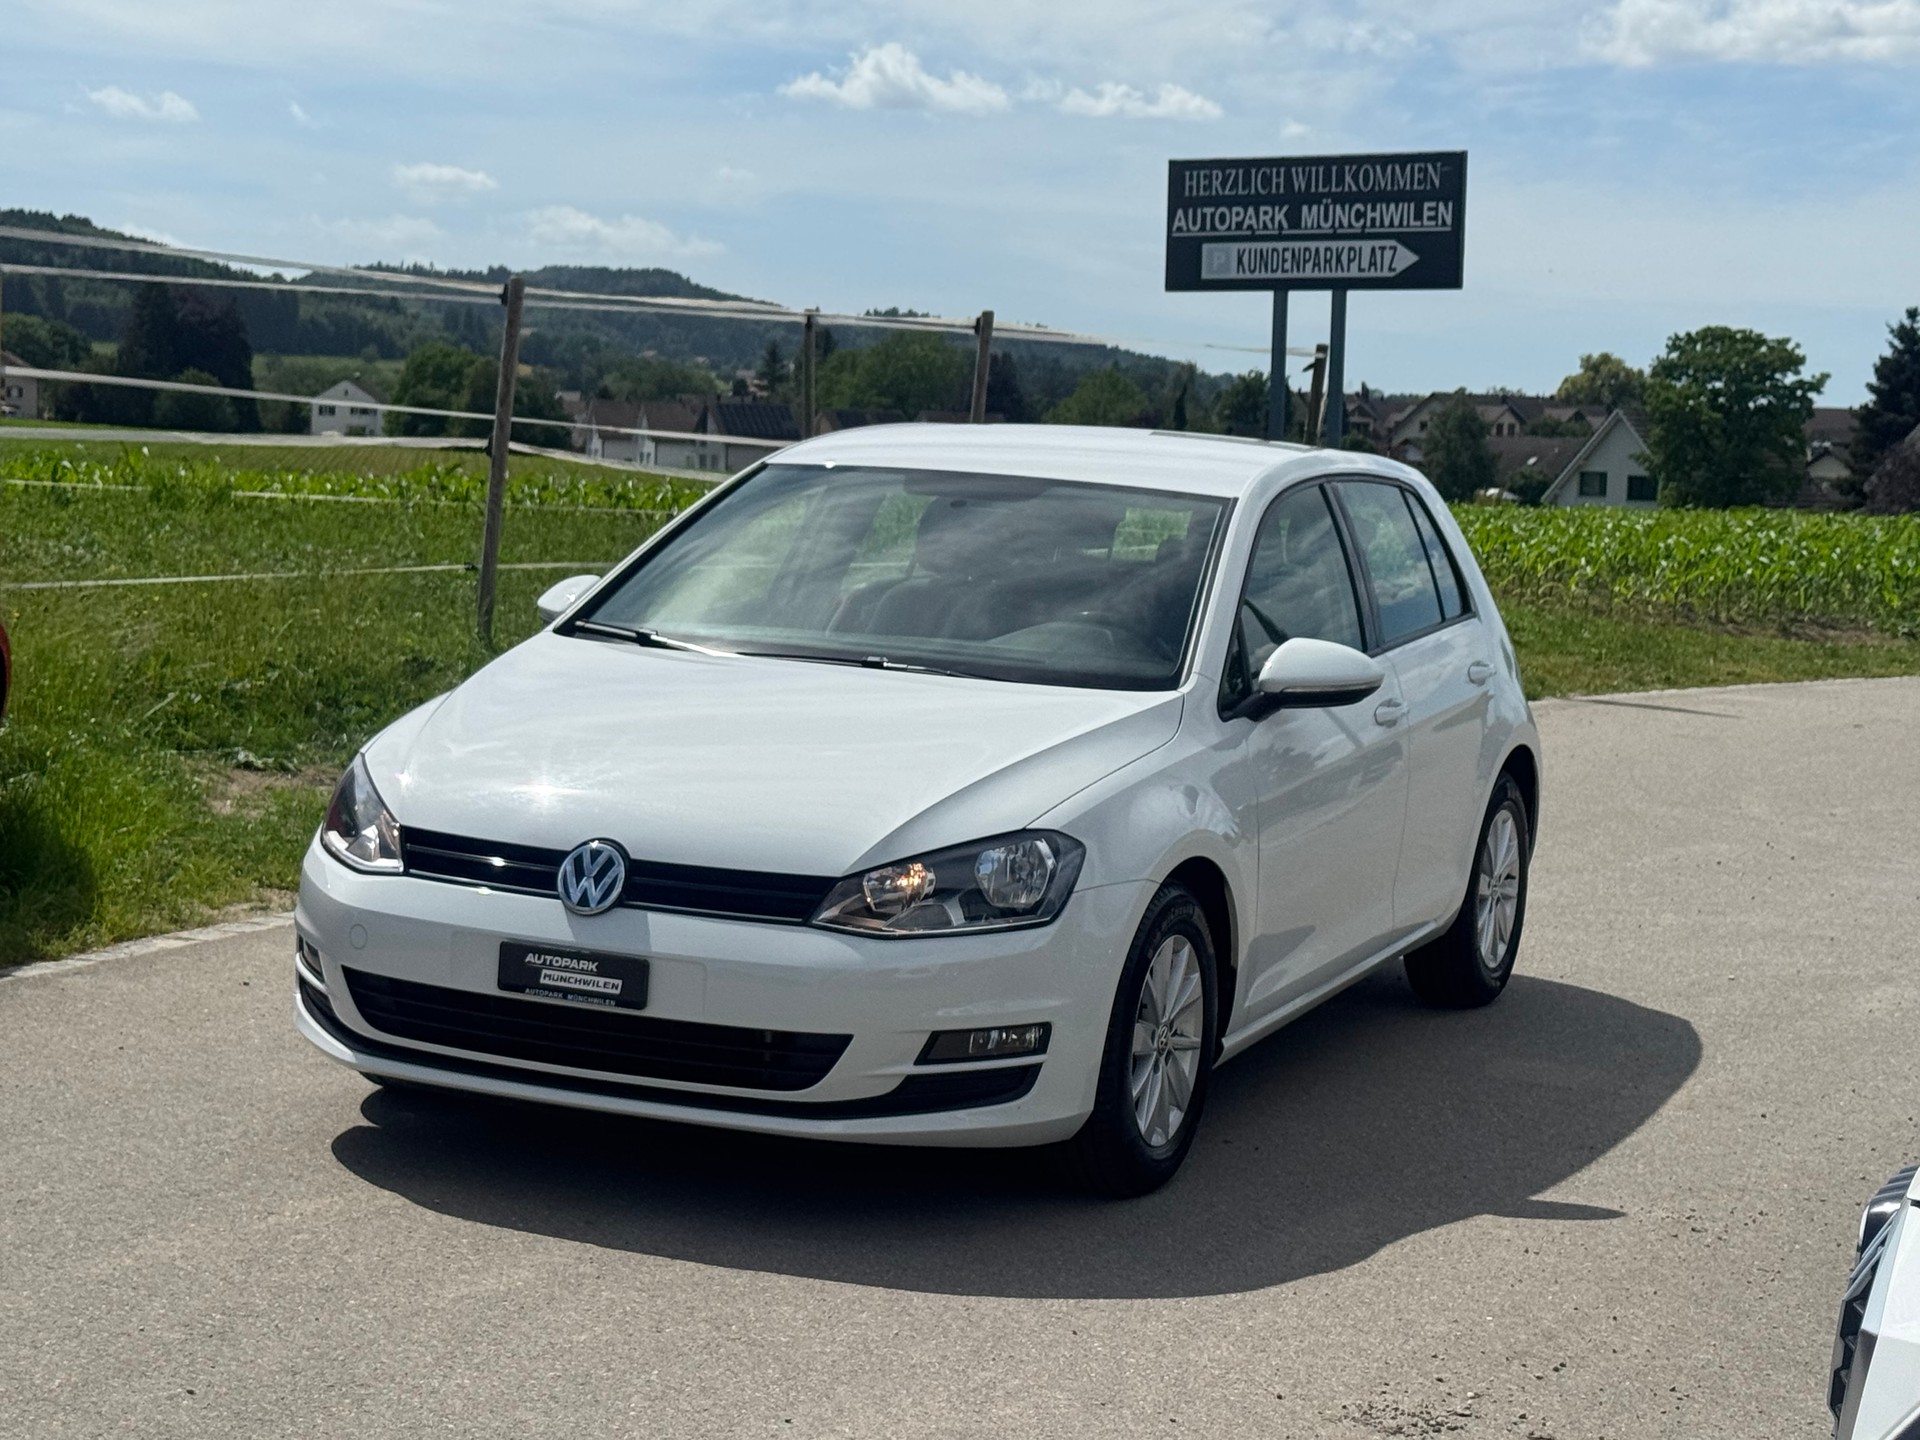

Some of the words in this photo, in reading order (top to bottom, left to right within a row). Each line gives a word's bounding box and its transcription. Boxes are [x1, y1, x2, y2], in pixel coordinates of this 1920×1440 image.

[1185, 167, 1286, 197] HERZLICH
[1291, 162, 1442, 193] WILLKOMMEN
[1172, 205, 1289, 232] AUTOPARK
[1301, 199, 1453, 228] MÜNCHWILEN
[1237, 246, 1398, 274] KUNDENPARKPLATZ
[559, 843, 625, 915] VW
[525, 953, 599, 971] AUTOPARK
[543, 971, 620, 991] MÜNCHWILEN
[525, 987, 563, 998] AUTOPARK
[567, 993, 616, 1006] MÜNCHWILEN
